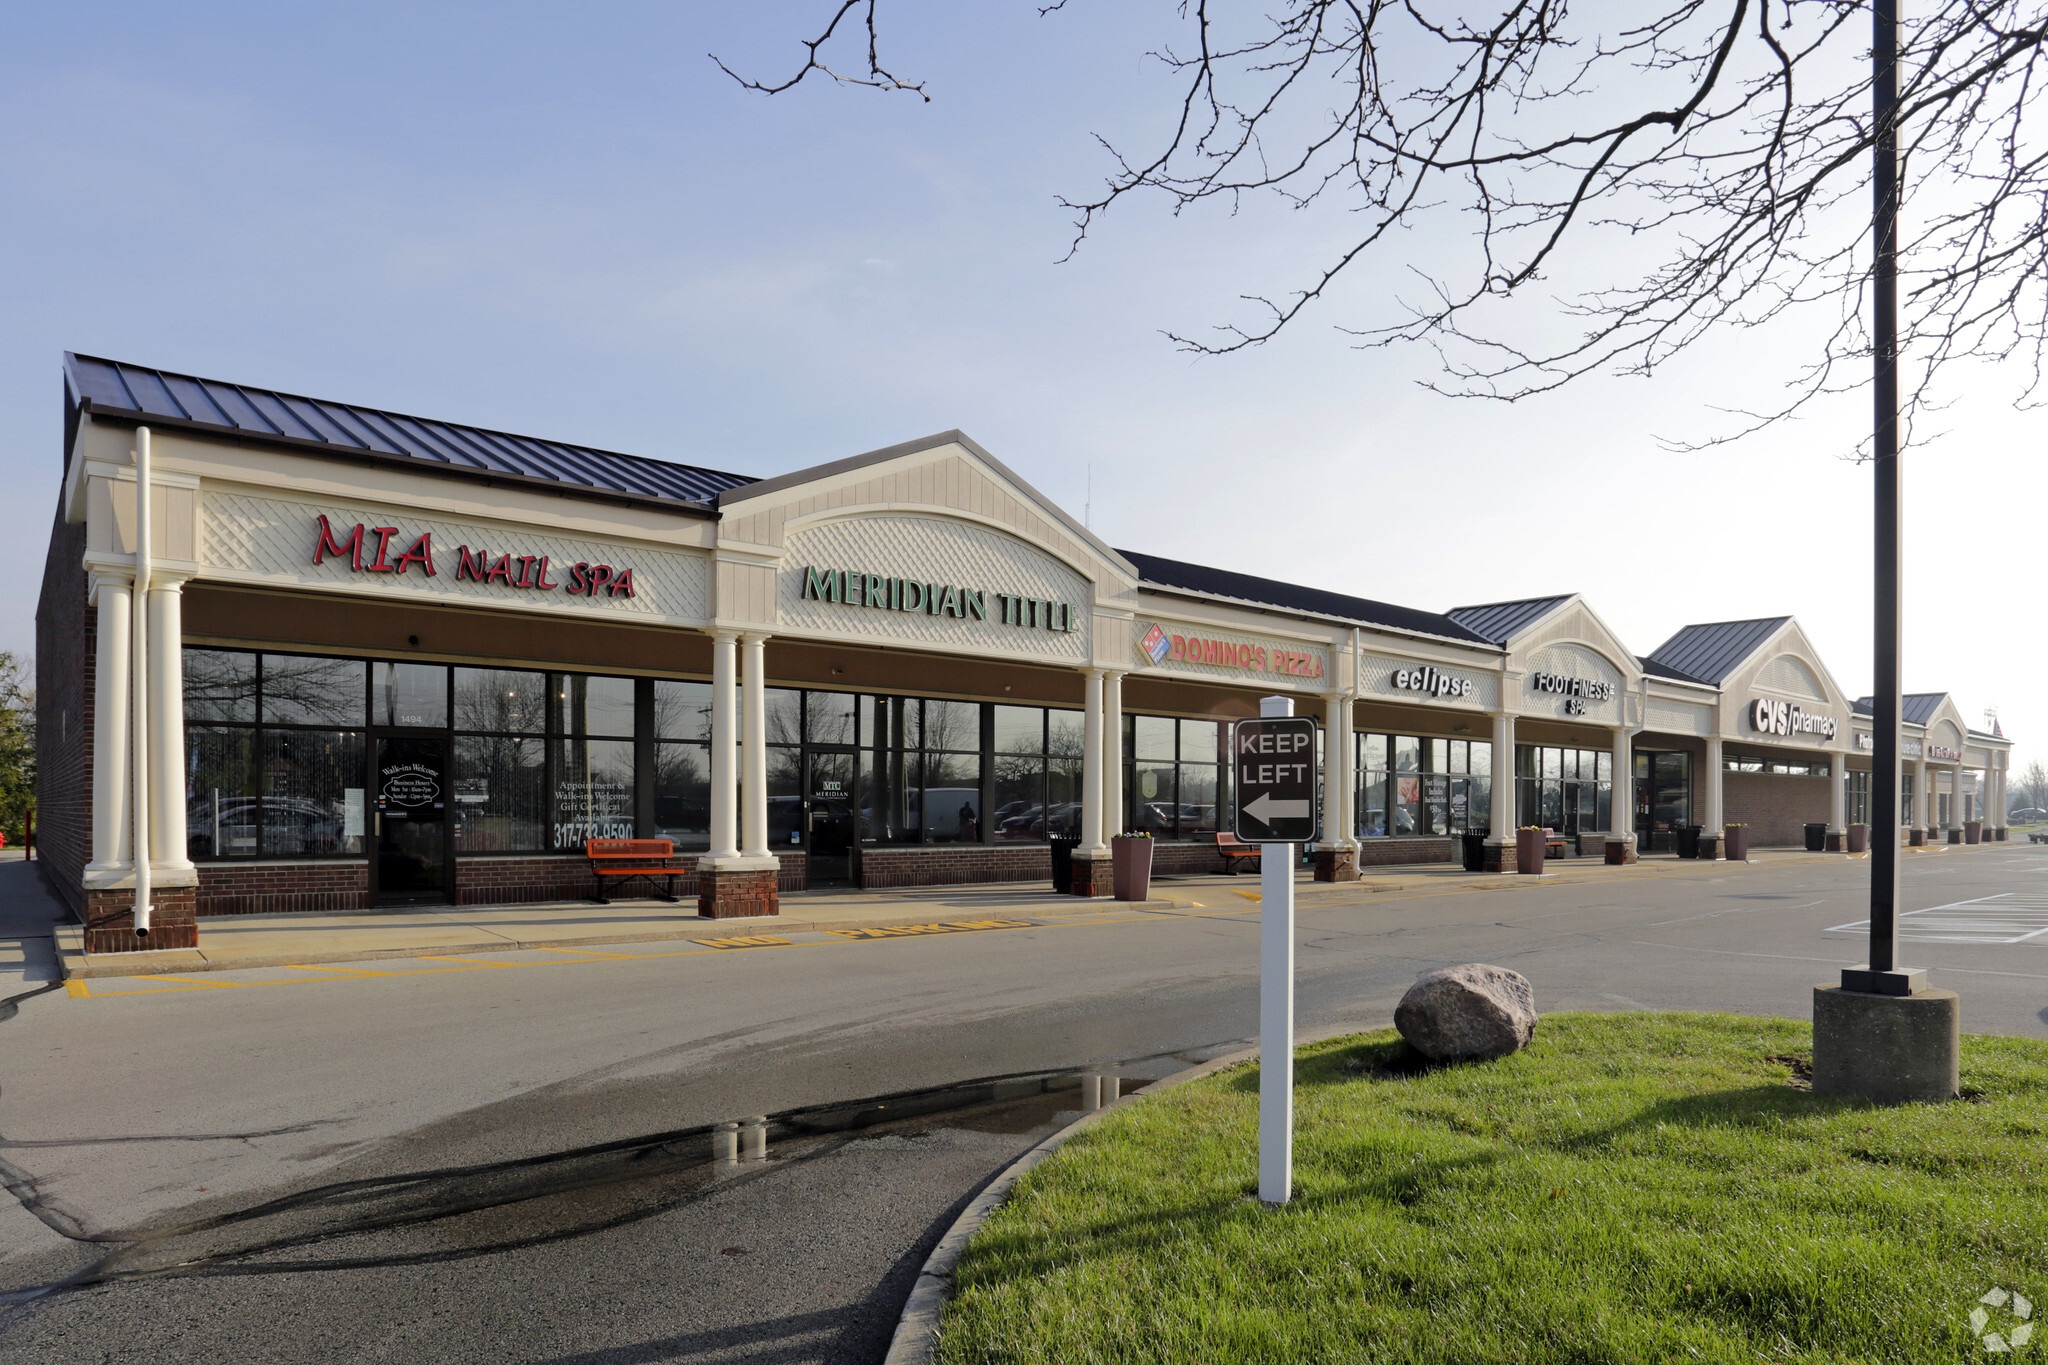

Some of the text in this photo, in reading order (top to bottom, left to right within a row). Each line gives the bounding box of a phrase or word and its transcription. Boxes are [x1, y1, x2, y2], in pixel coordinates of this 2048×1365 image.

[313, 514, 636, 598] MIA NAIL SPA
[802, 565, 1079, 633] MERIDIAN TITLE
[1171, 635, 1325, 677] DOMINO'S PIZZA
[1394, 666, 1472, 697] eclipse
[1539, 672, 1615, 700] FOOT FINESSE
[1569, 699, 1586, 715] SPA
[401, 715, 422, 723] 1494
[1756, 698, 1838, 741] CVS/pharmacy
[1241, 733, 1309, 754] KEEP
[382, 763, 439, 777] Walk-ins Welcome
[1243, 764, 1307, 784] LEFT
[554, 791, 630, 800] Walk-ins Welcome
[560, 781, 615, 790] Appointment
[560, 802, 577, 811] Gift
